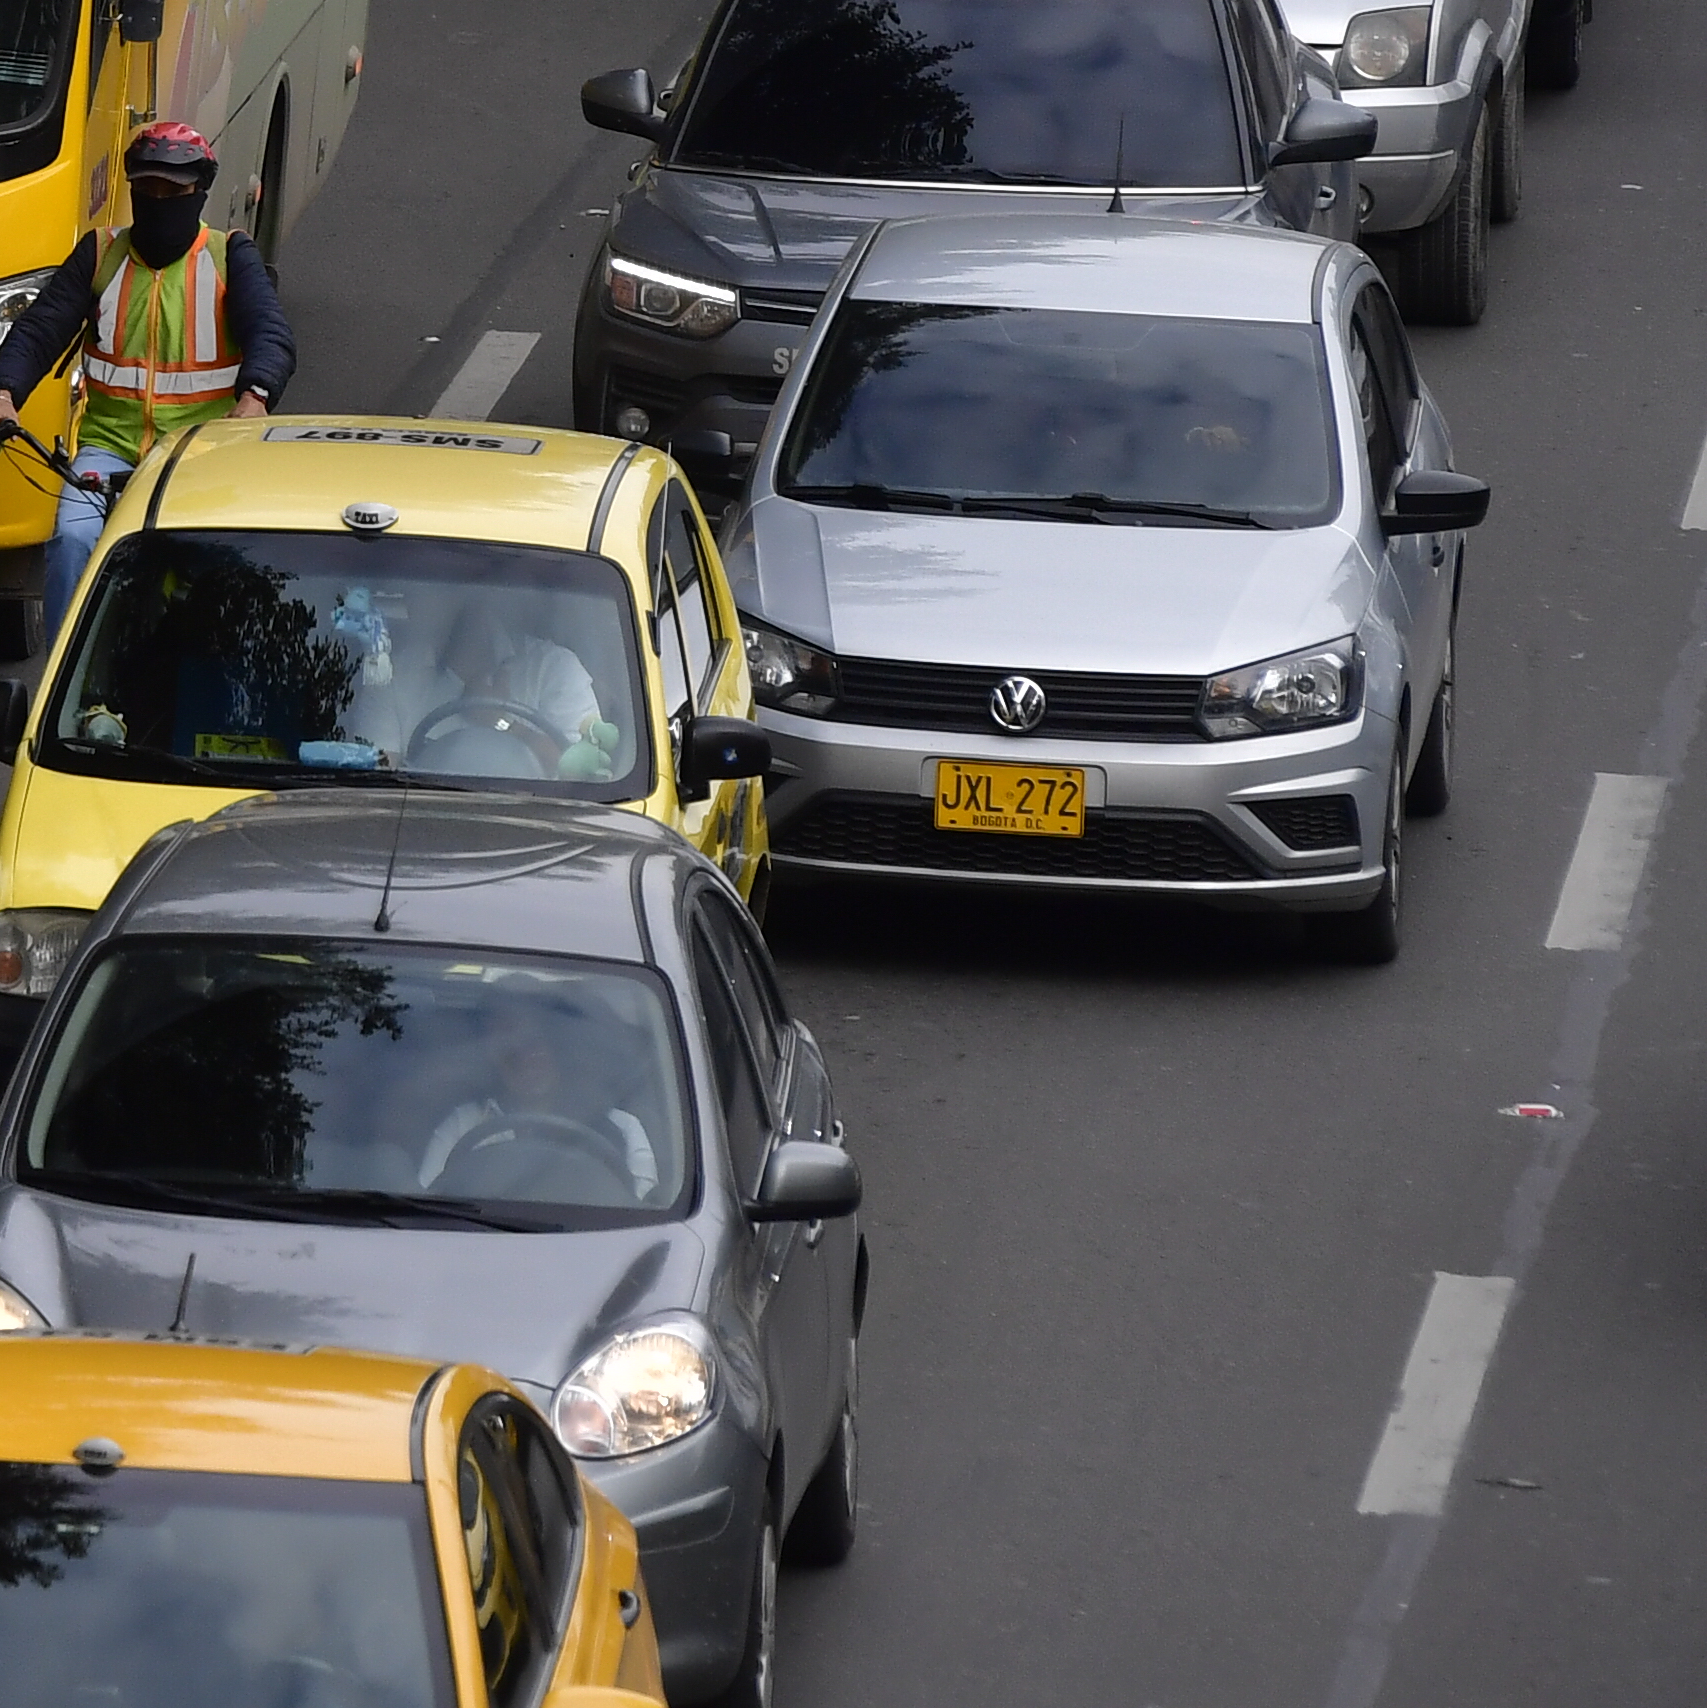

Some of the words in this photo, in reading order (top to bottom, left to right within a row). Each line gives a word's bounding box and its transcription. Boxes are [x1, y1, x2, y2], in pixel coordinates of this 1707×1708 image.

[772, 347, 799, 374] S
[354, 511, 380, 525] TAXI
[972, 815, 1017, 828] BOGOTA
